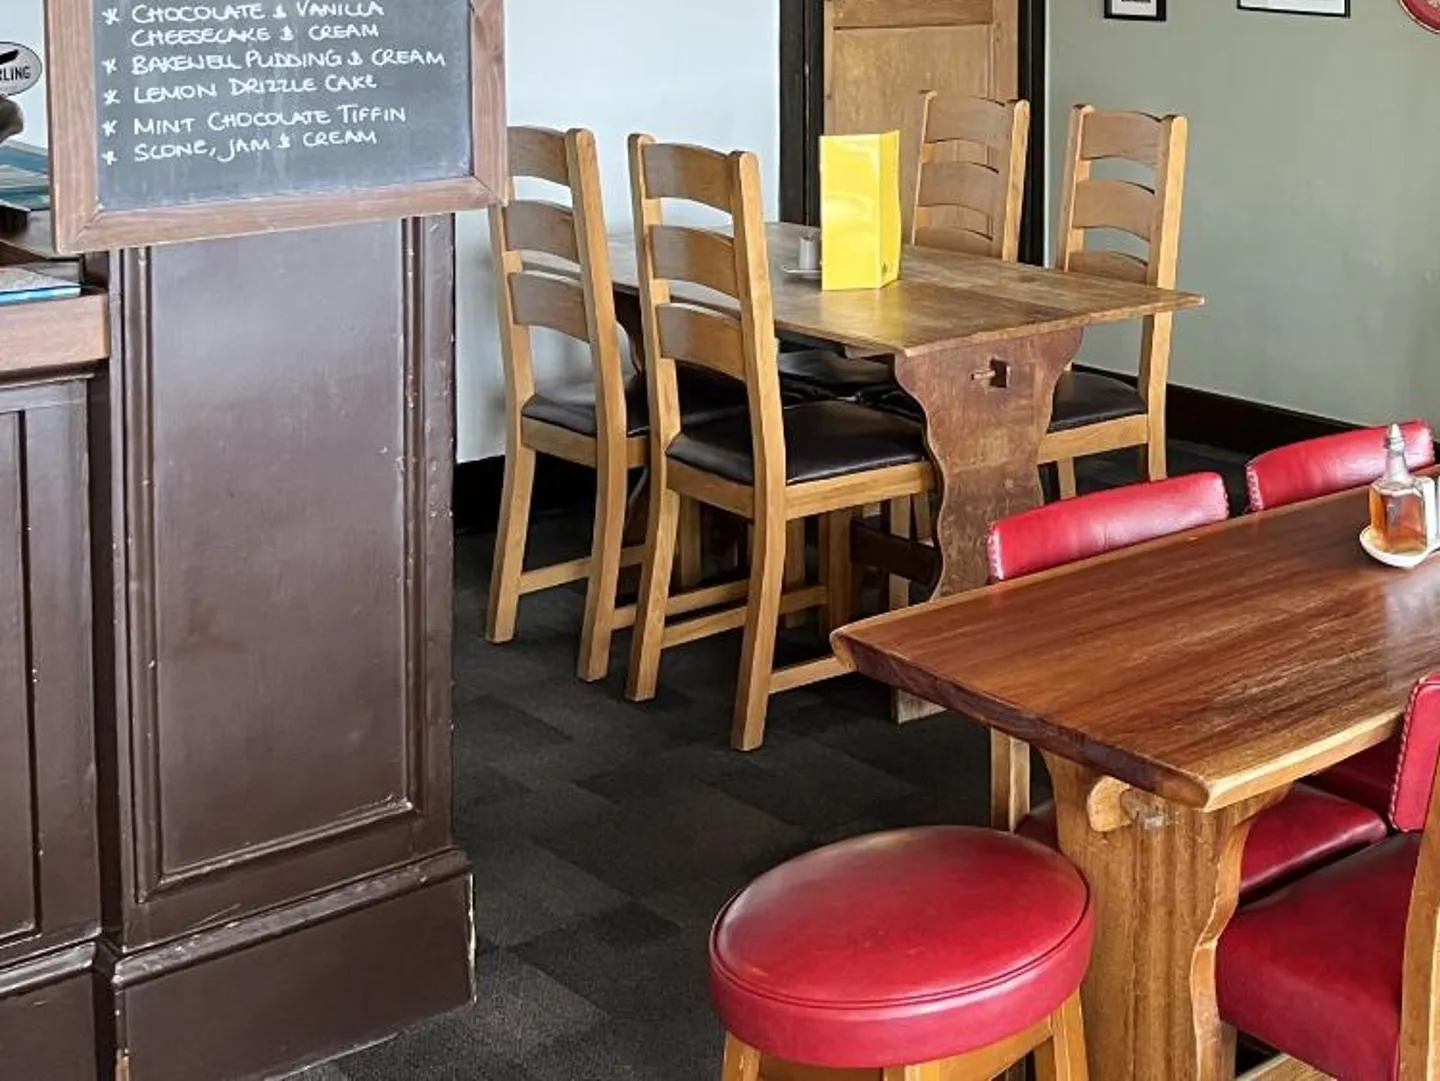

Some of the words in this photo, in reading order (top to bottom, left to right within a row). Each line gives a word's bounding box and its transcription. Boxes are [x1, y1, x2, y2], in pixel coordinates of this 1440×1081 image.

[131, 3, 266, 24] CHOCOLATE
[130, 27, 272, 47] CHEESECAKE
[308, 24, 380, 41] CREAM
[0, 65, 32, 82] LING
[131, 54, 243, 75] BAKEWELL
[245, 49, 343, 69] PUDDING
[371, 48, 447, 67] CREAM
[133, 82, 218, 104] LEMON
[228, 77, 318, 96] DRIZZLE
[133, 118, 197, 136] MINT
[207, 111, 332, 132] CHOCOLATE
[336, 104, 407, 123] TIFFIN
[216, 137, 272, 163] JAM
[302, 131, 378, 148] CREAM
